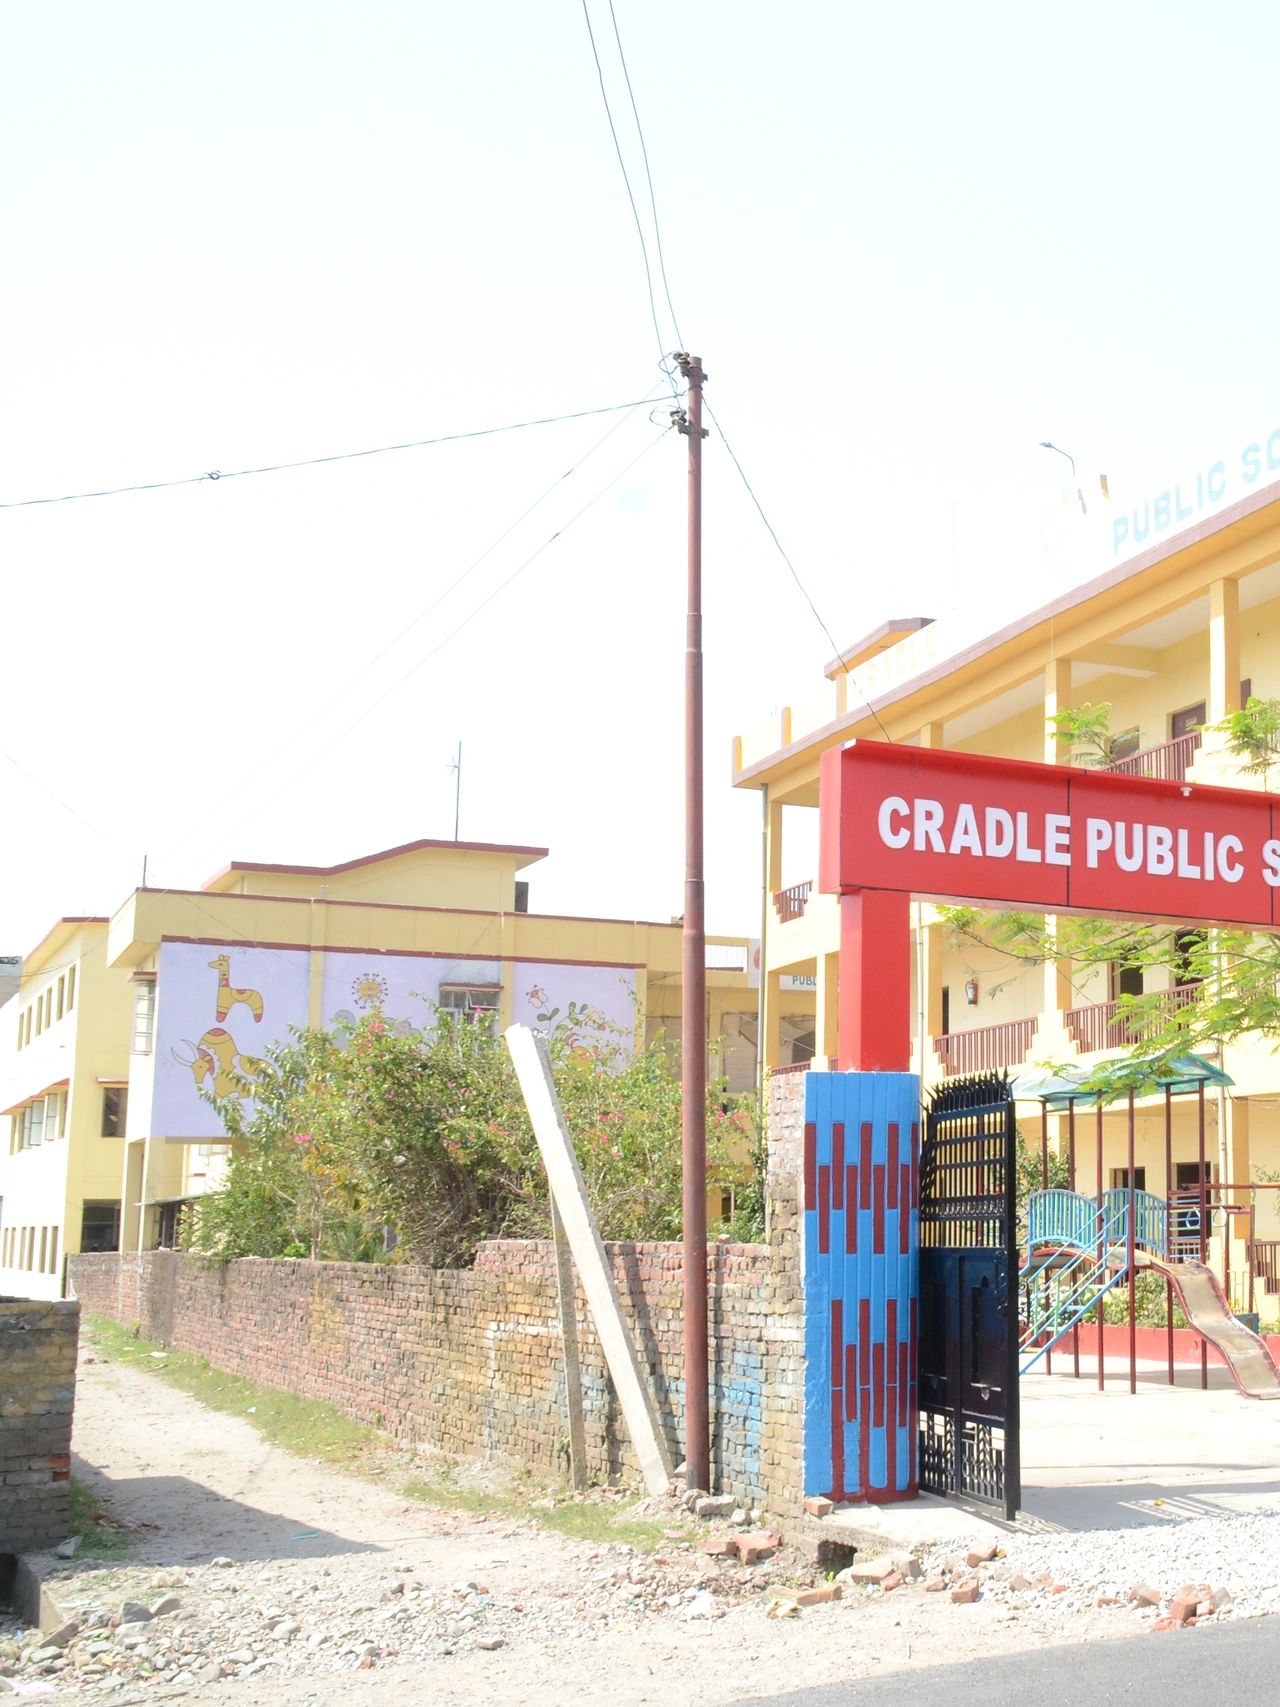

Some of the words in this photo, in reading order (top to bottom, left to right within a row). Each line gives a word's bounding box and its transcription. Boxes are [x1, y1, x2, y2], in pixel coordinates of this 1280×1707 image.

[1112, 460, 1226, 556] PUBLIC
[877, 796, 1071, 867] CRADLE
[1085, 818, 1245, 885] PUBLIC
[792, 975, 817, 986] PUBL
